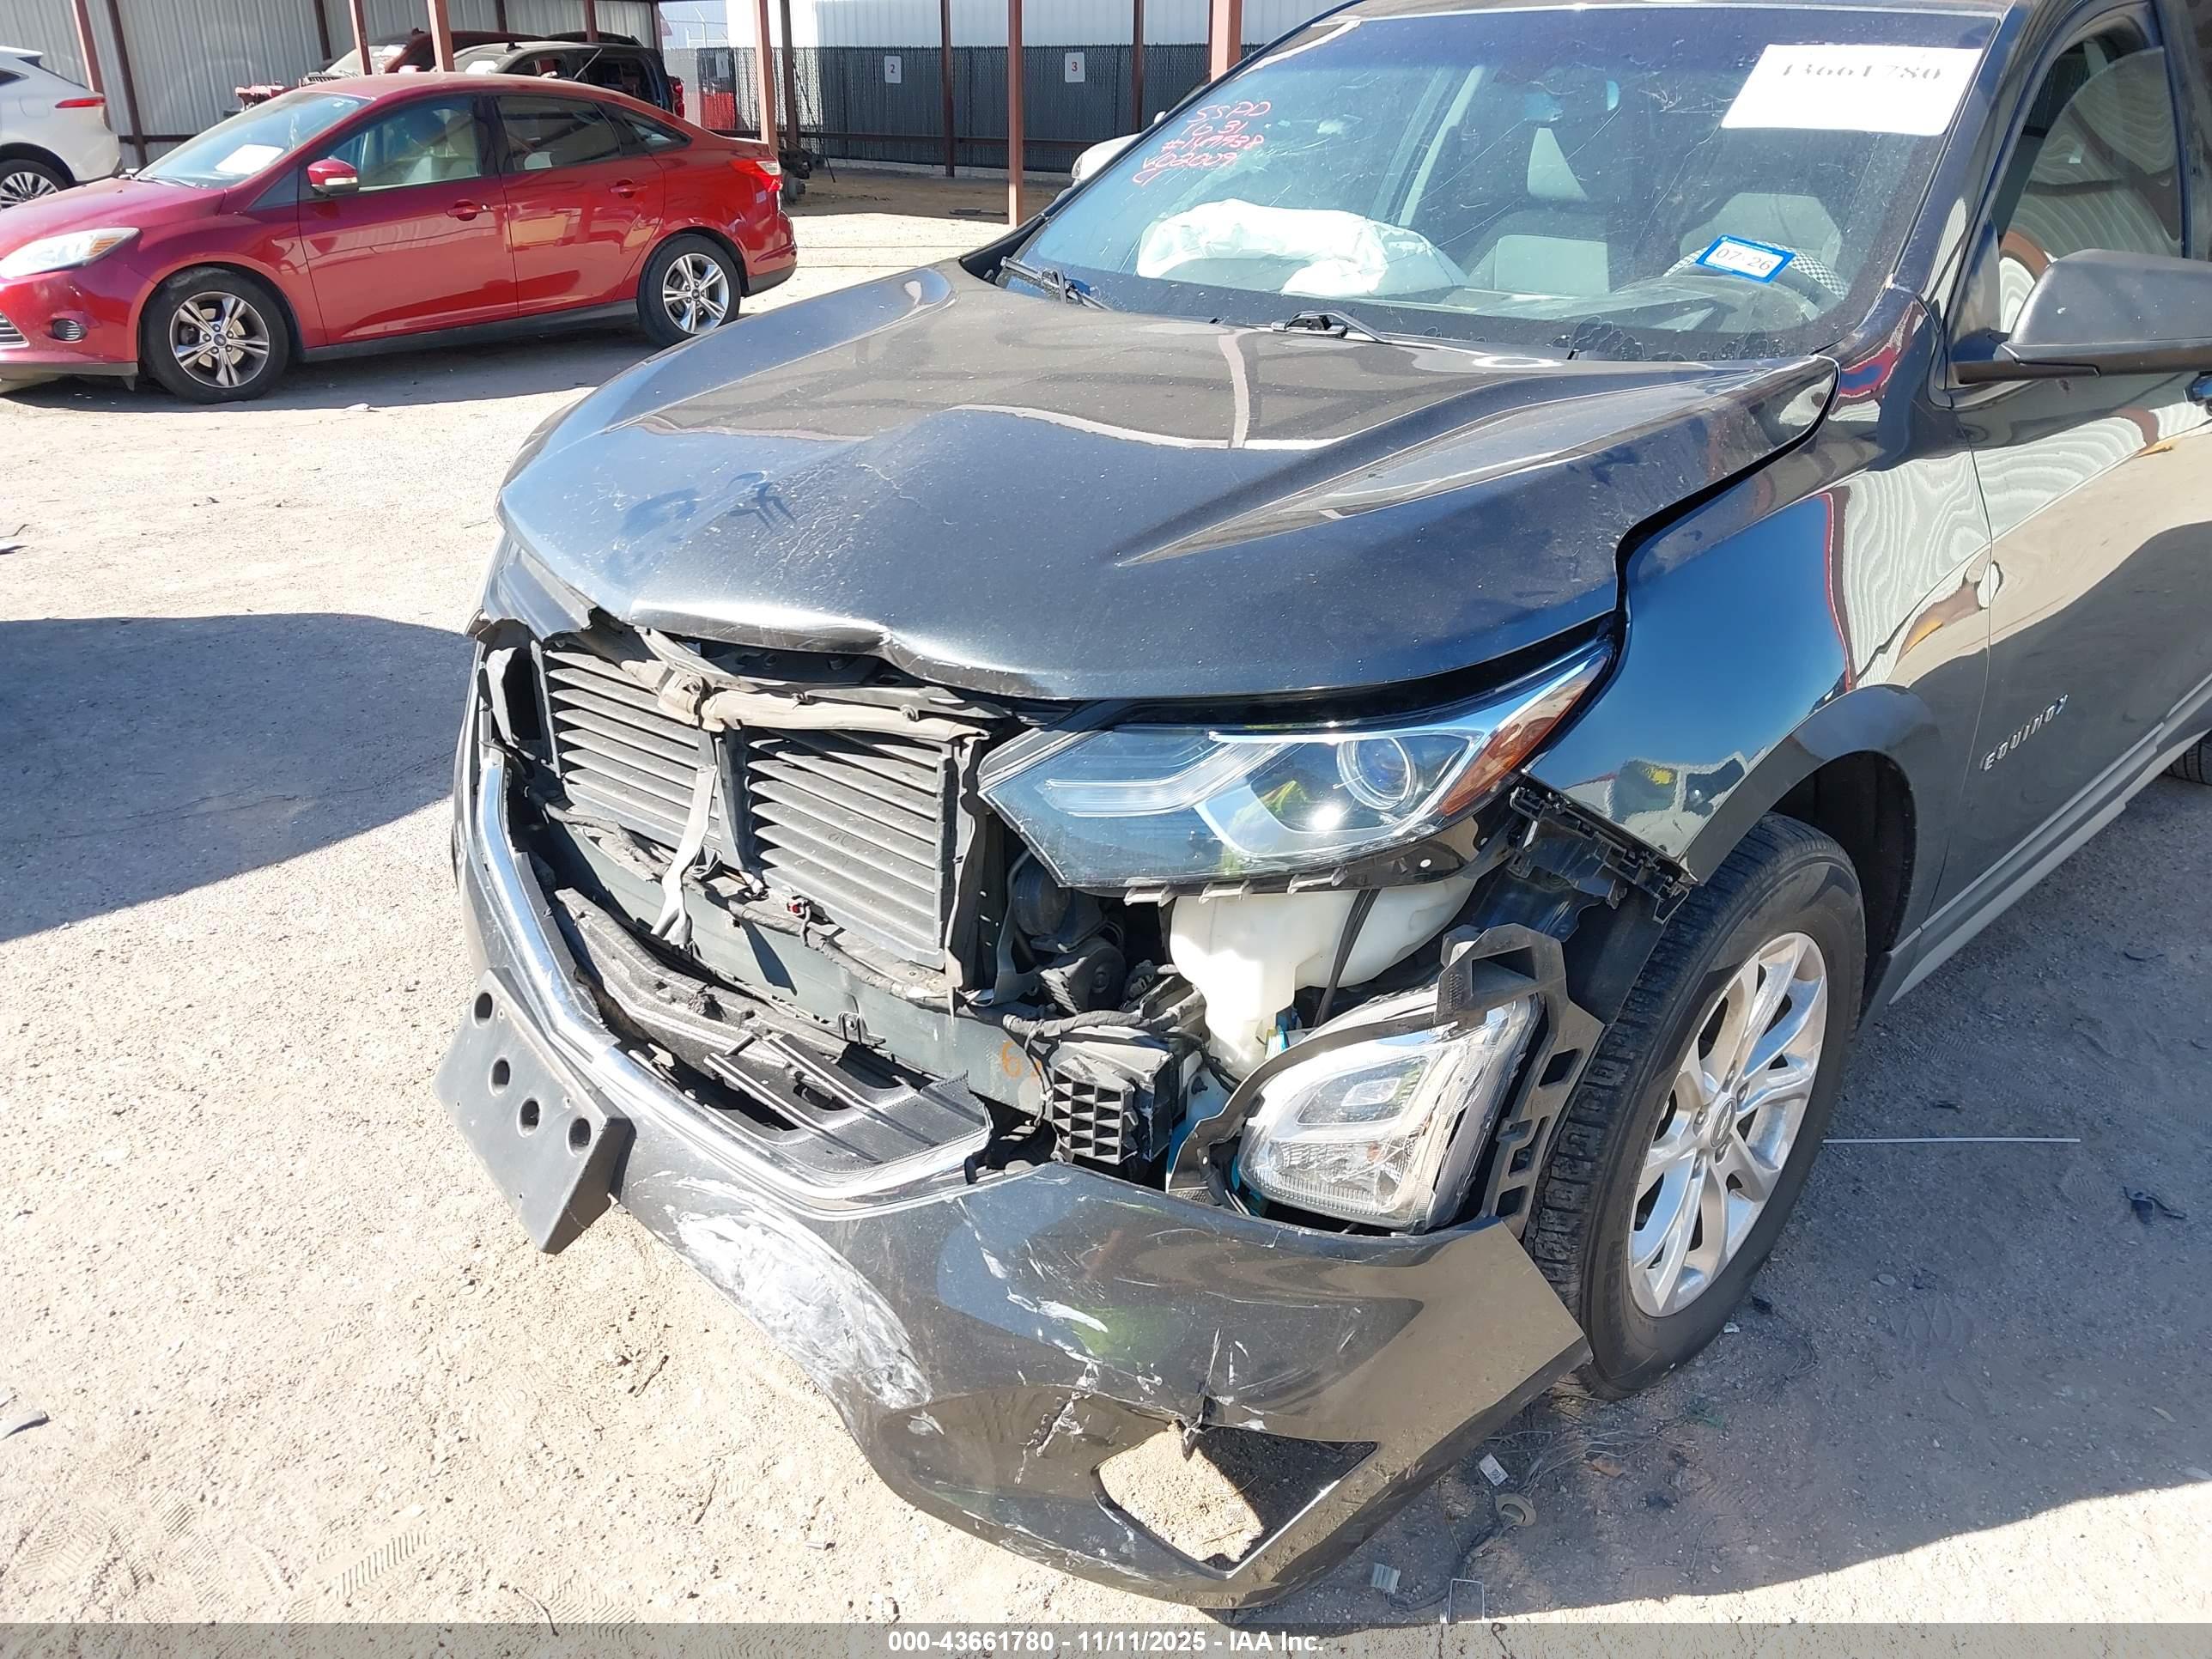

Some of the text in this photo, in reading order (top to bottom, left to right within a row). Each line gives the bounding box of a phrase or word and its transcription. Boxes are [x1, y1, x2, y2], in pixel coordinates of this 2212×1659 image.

[889, 64, 896, 74] 2
[1071, 61, 1079, 72] 3
[1980, 693, 2069, 771] EQUINOX
